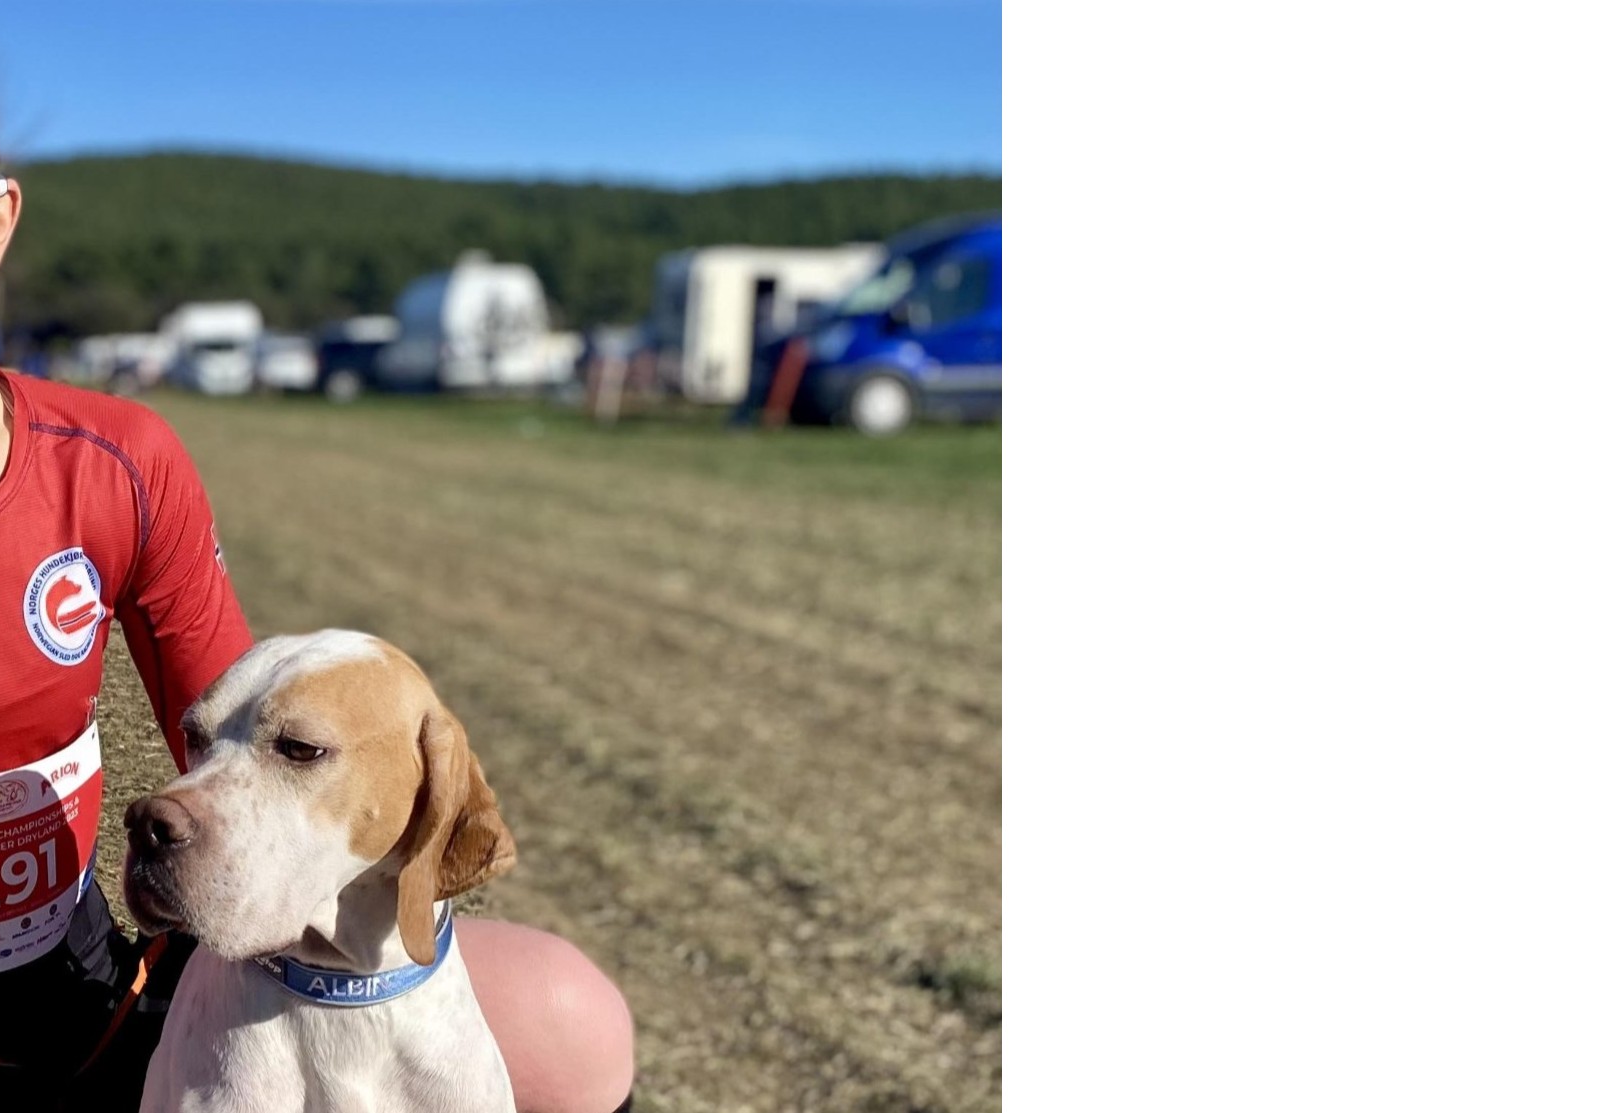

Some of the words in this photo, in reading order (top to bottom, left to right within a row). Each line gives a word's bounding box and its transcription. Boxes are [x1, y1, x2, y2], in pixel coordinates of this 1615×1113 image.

[28, 578, 43, 616] NORGES
[32, 622, 60, 658] NORWEGIAN
[40, 761, 80, 798] ARION
[17, 820, 61, 846] DRYLAND
